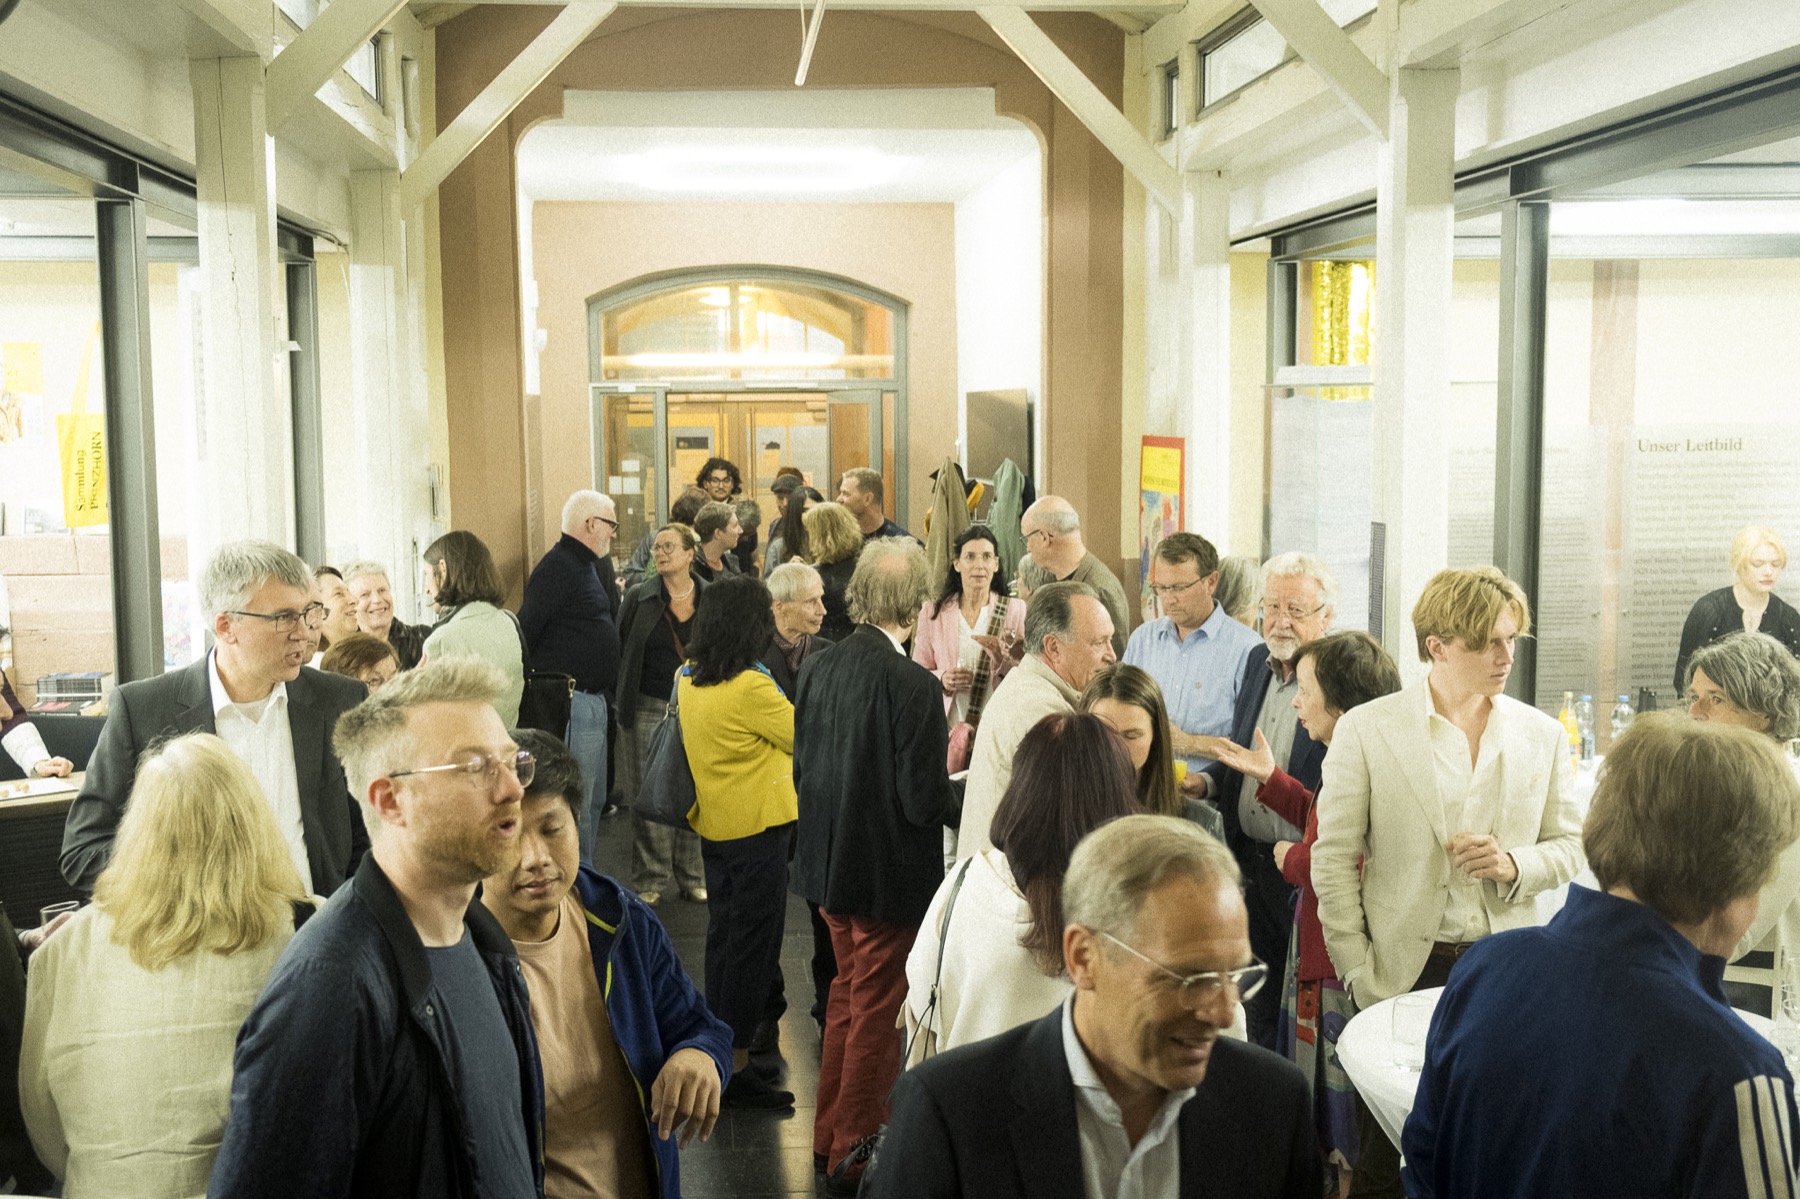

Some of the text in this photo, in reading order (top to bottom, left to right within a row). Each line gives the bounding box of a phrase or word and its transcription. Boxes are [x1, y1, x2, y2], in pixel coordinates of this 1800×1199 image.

[1637, 437, 1743, 453] Unser Leitbild
[75, 449, 87, 512] Sammlung
